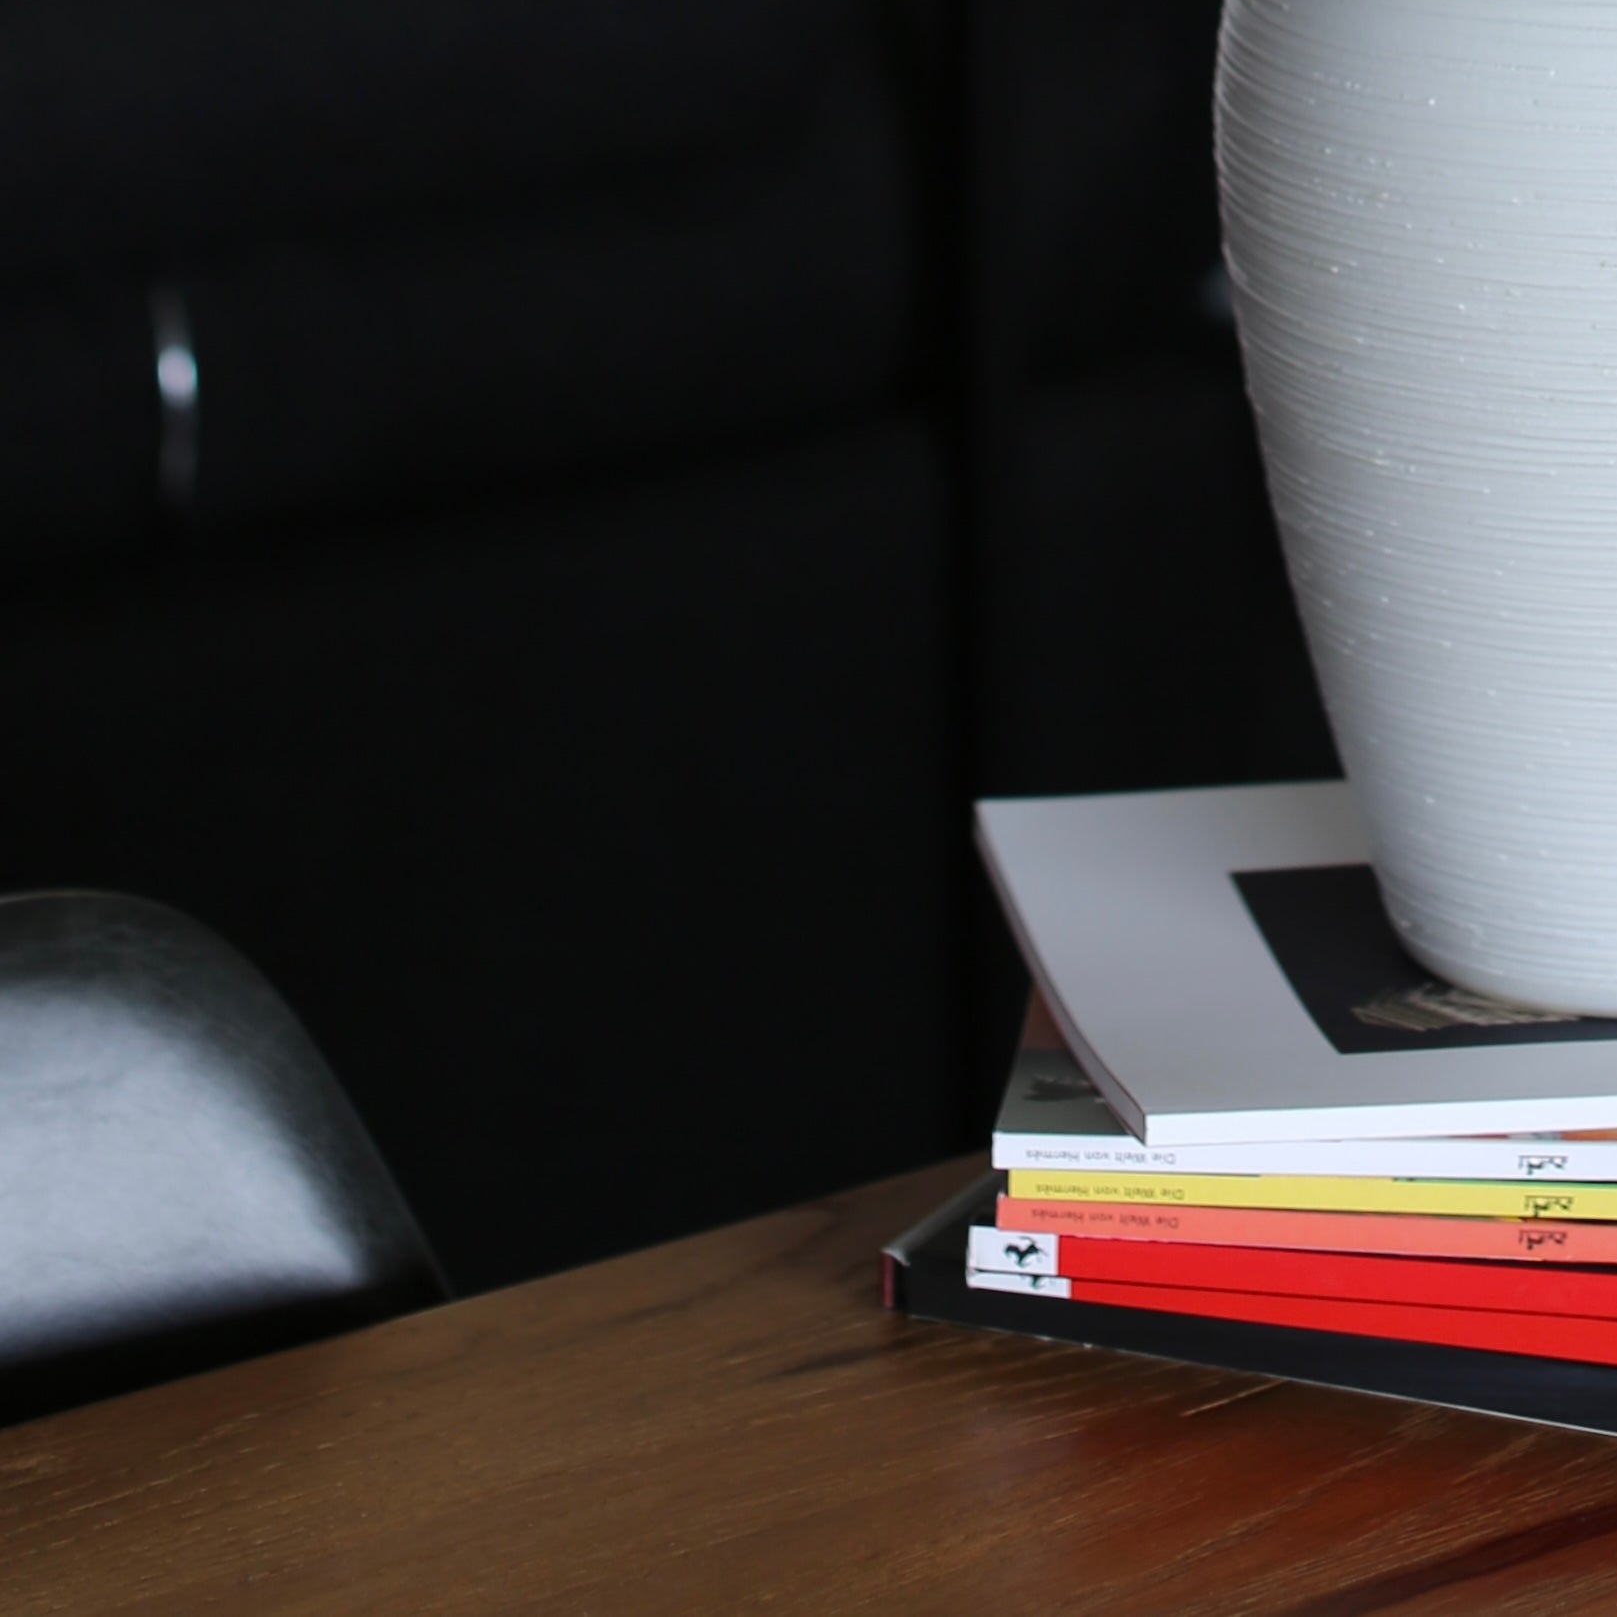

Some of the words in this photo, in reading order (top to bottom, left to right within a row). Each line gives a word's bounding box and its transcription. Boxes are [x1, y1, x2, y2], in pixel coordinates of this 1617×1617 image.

[1084, 1151, 1109, 1161] von
[1115, 1152, 1146, 1164] Welt
[1152, 1152, 1176, 1164] Die
[1093, 1186, 1118, 1196] von
[1124, 1188, 1155, 1199] Welt
[1160, 1189, 1184, 1200] Die
[1089, 1213, 1114, 1223] von
[1119, 1214, 1150, 1227] Welt
[1155, 1216, 1179, 1229] Die
